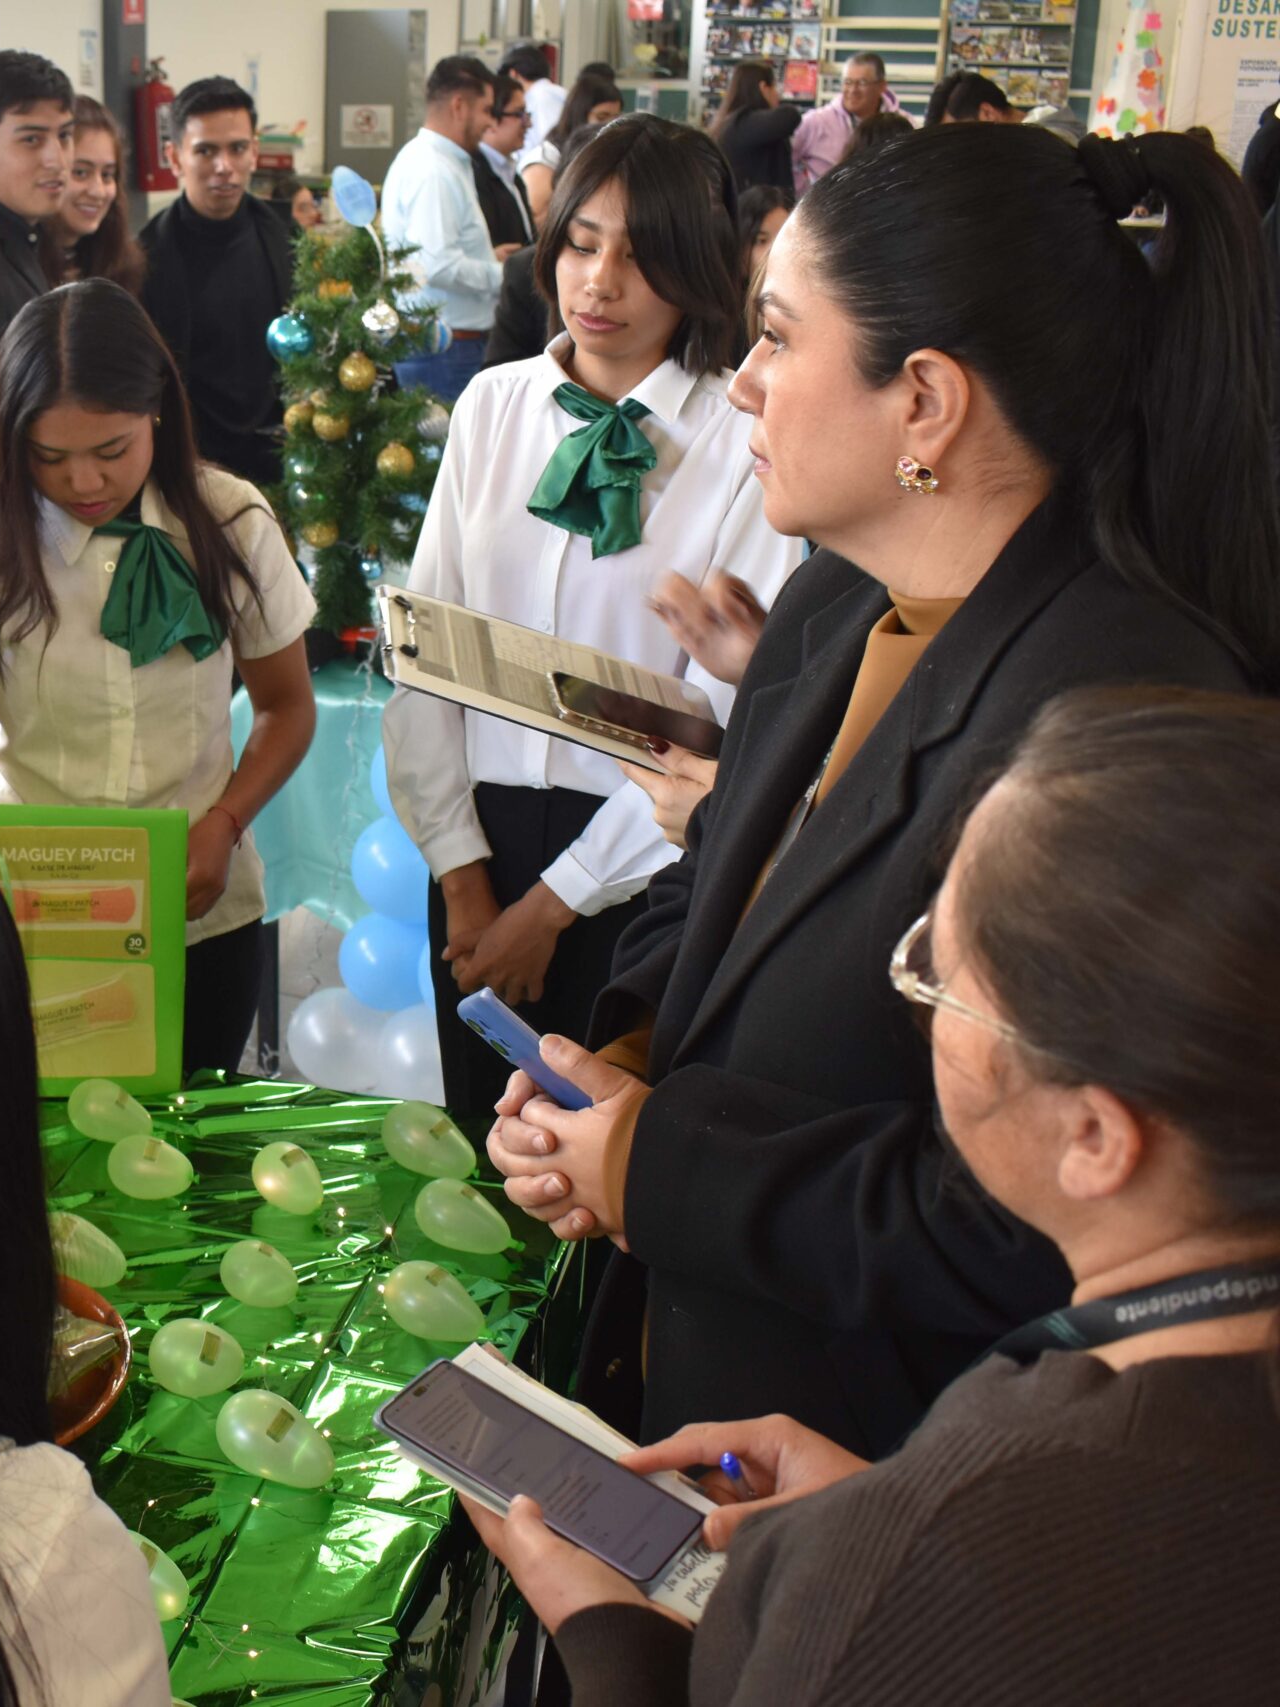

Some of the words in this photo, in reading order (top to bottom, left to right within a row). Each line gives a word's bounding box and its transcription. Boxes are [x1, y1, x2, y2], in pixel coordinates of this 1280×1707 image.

[2, 847, 74, 862] MAGUEY
[81, 847, 135, 862] PATCH
[129, 938, 142, 947] 30
